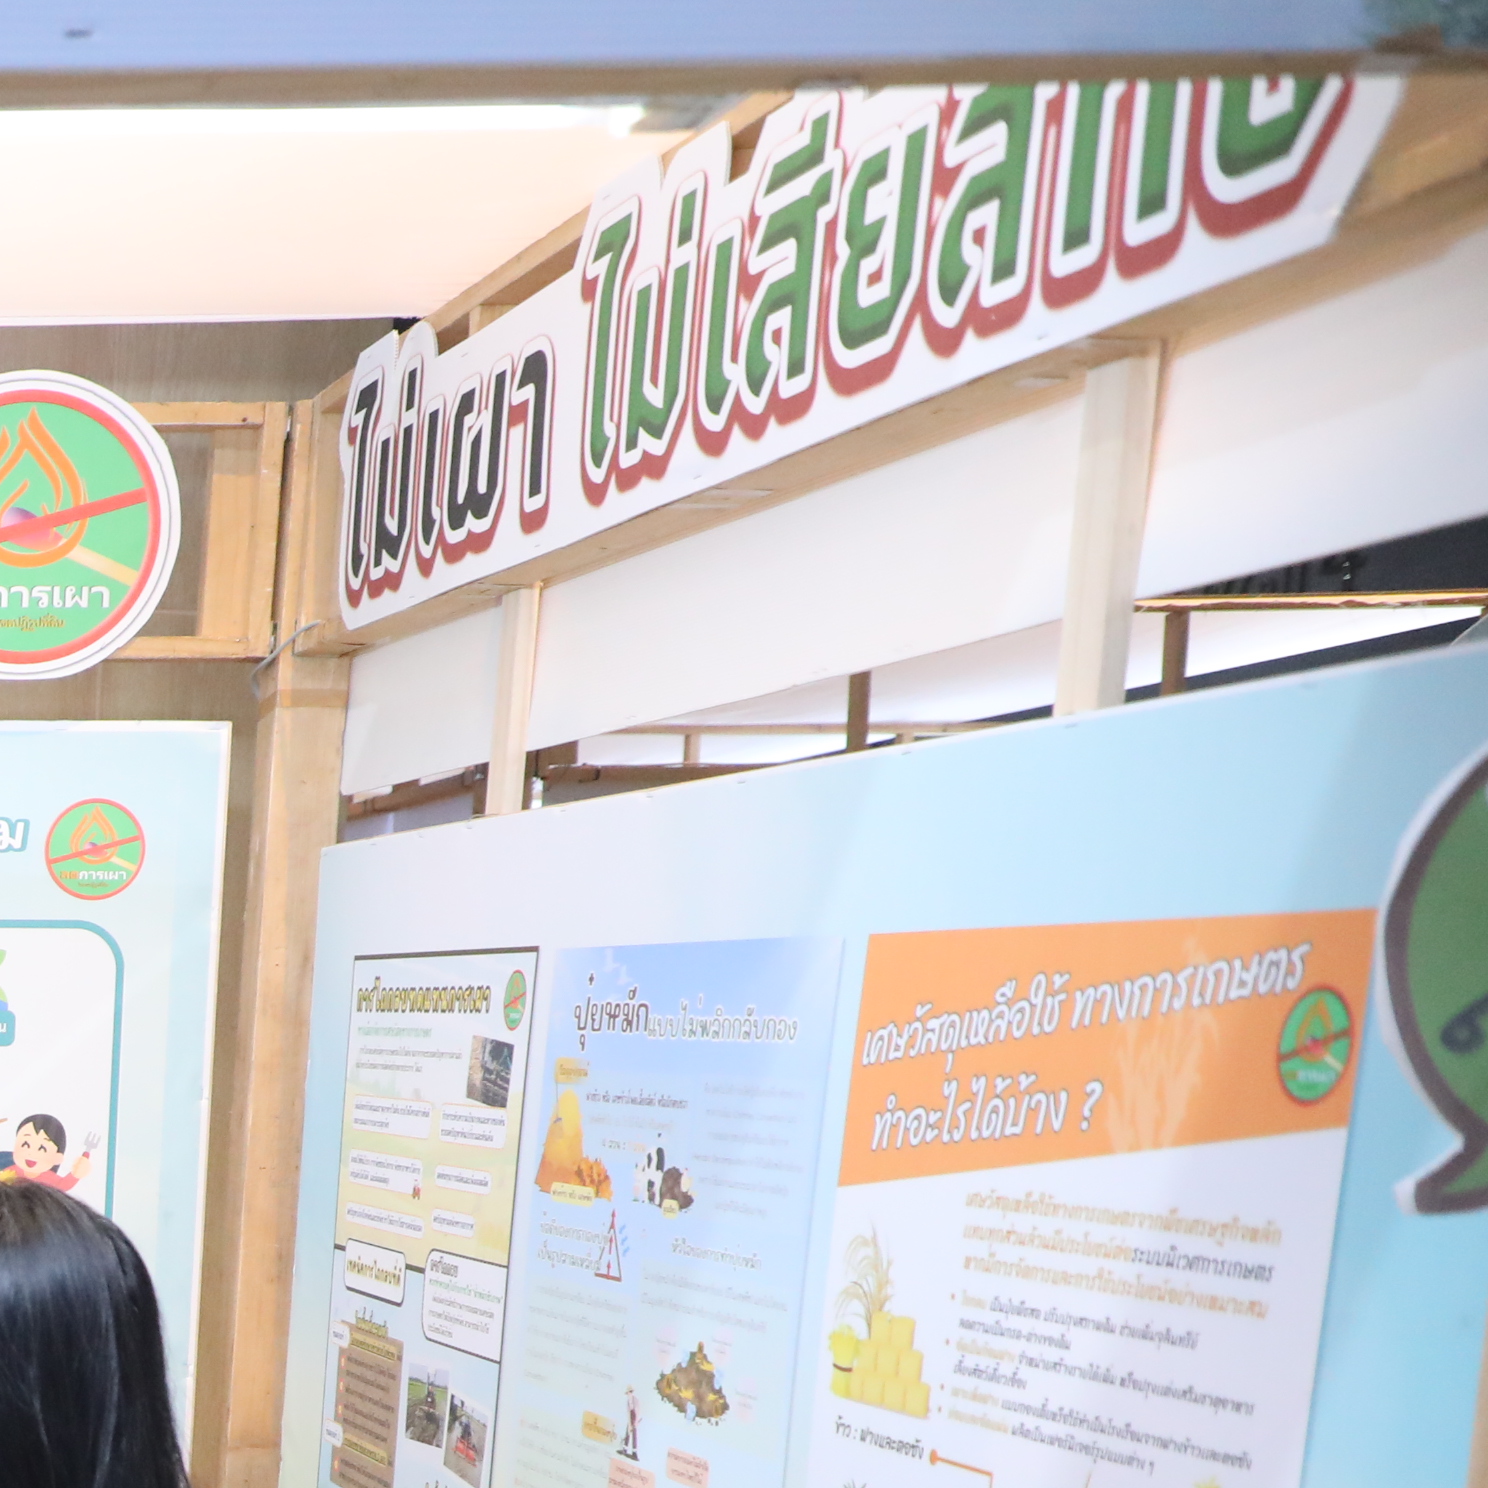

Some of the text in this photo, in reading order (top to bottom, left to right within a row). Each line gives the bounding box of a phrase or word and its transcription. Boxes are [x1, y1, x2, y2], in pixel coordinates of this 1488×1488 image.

[348, 338, 552, 586] ไม่เผา
[861, 942, 1312, 1073] เศษวัสดุเหลือใช้ ทางการเกษตร
[871, 1072, 1069, 1151] ทำอะไรได้บ้าง
[1081, 1080, 1103, 1132] ?
